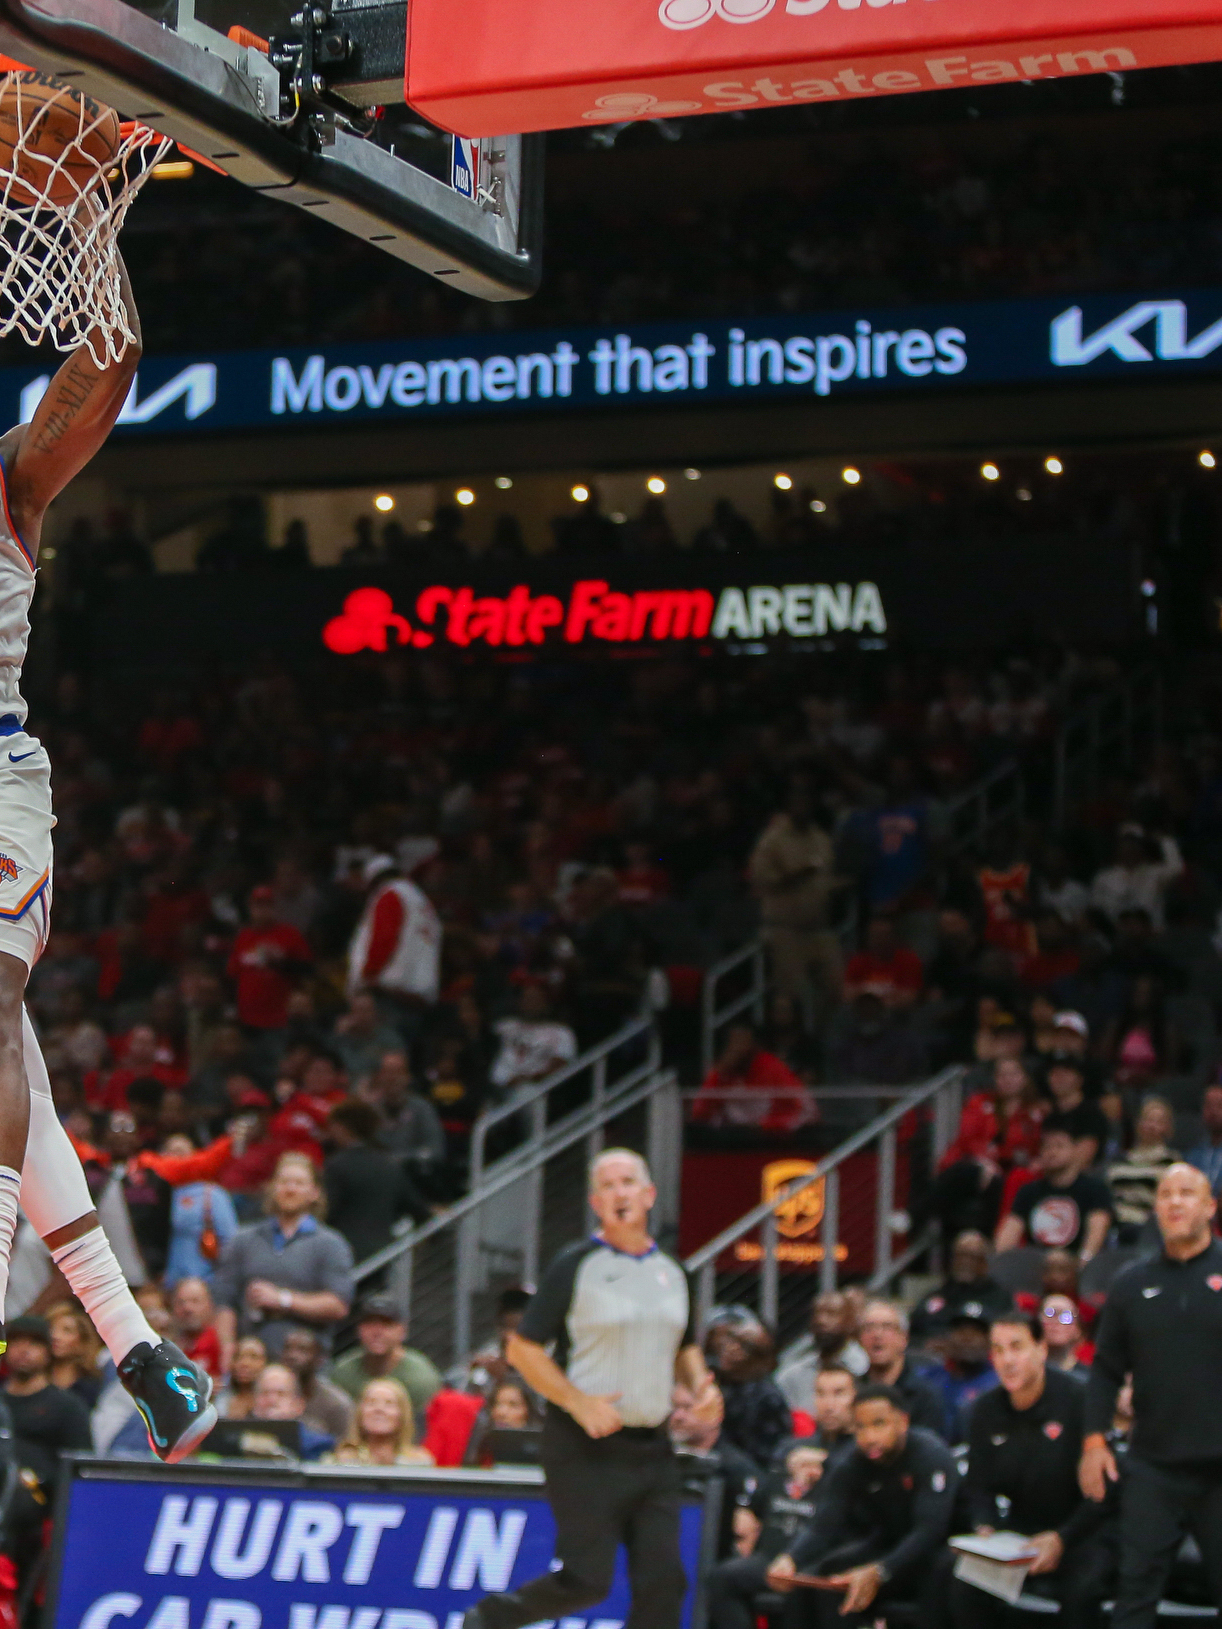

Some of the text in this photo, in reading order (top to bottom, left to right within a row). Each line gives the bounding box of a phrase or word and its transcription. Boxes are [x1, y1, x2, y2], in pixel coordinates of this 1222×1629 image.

[703, 45, 1138, 108] State Farm
[455, 164, 469, 193] NBA
[270, 341, 580, 414] Movement
[589, 333, 716, 394] that
[728, 319, 968, 396] inspires
[566, 579, 714, 643] Farm
[712, 581, 887, 640] ARENA
[143, 1494, 528, 1592] HURT IN
